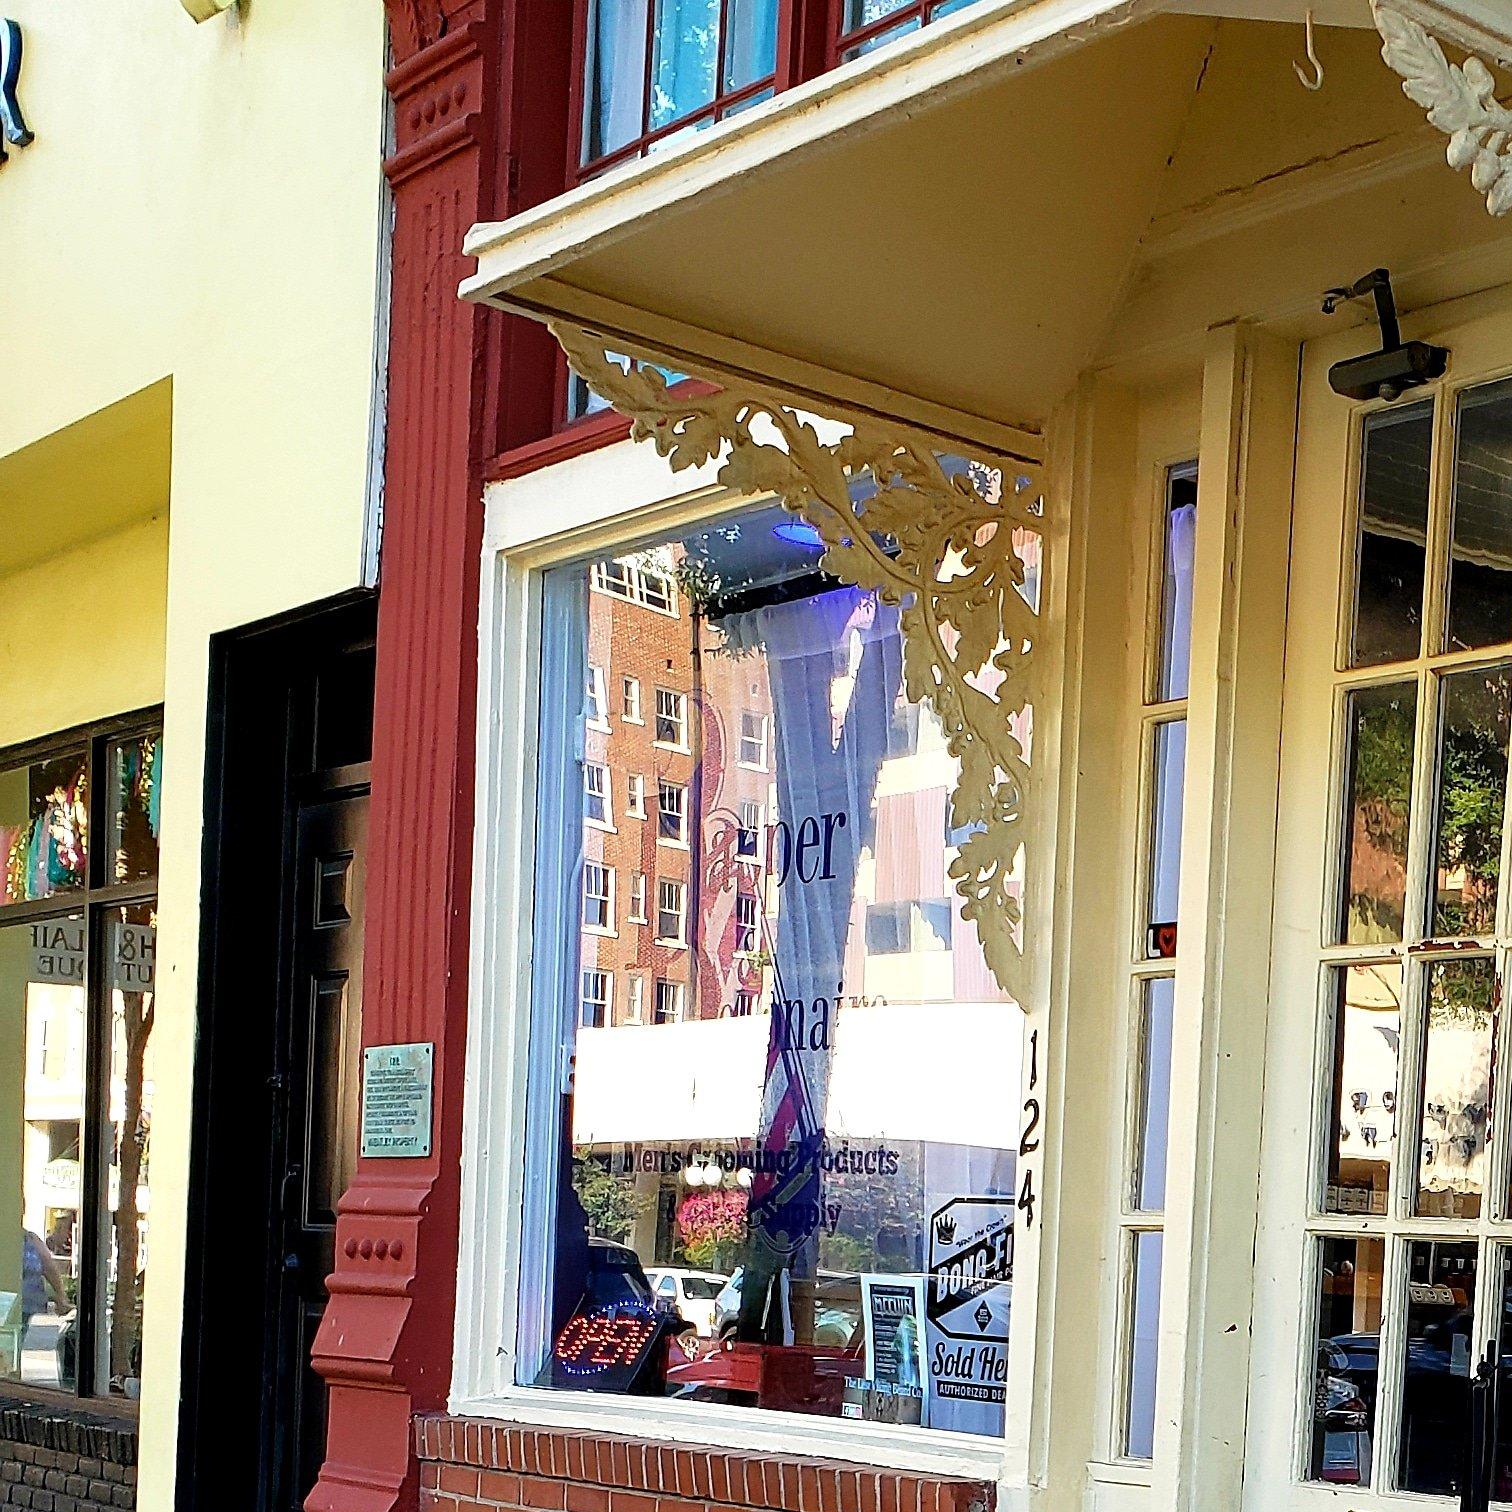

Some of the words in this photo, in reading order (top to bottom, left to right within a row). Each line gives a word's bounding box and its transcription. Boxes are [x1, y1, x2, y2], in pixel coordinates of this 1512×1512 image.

[1018, 1029, 1040, 1231] 124
[557, 1317, 657, 1365] OPEN
[931, 1341, 976, 1380] Sold
[939, 1383, 989, 1399] AUTHORIZED
